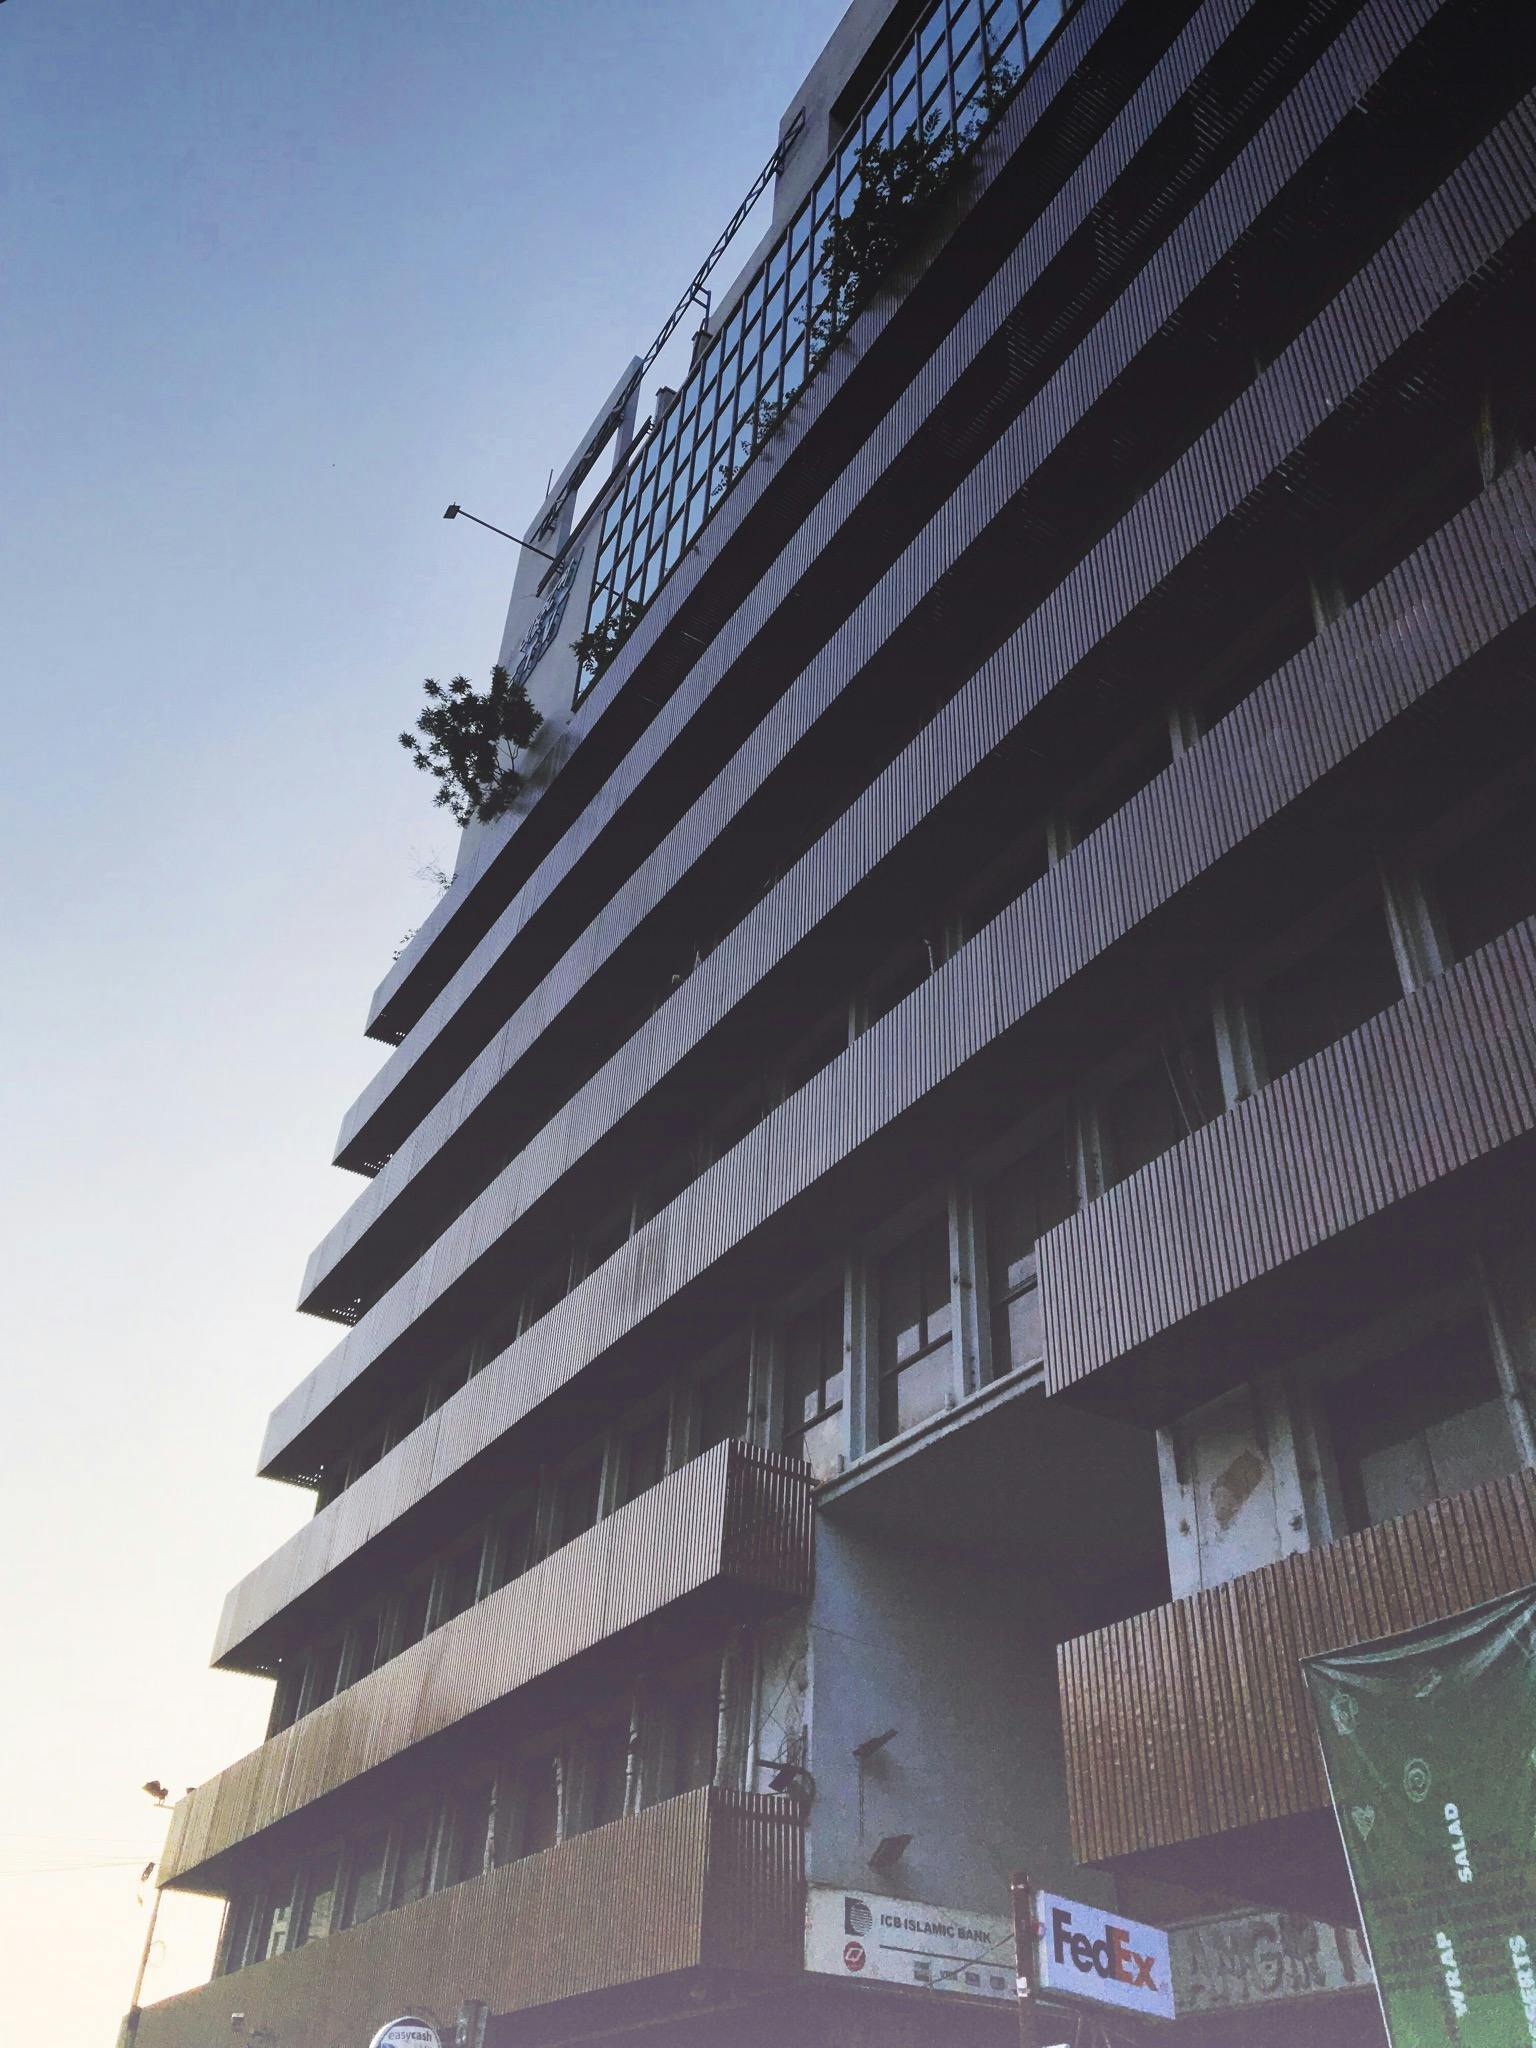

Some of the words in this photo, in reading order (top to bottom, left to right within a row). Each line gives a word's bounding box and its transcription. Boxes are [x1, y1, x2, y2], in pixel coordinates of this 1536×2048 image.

[1444, 1803, 1473, 1883] SALAD
[880, 1914, 901, 1929] ICB
[904, 1918, 955, 1938] ISLAMIC
[958, 1927, 992, 1943] BANK
[1052, 1907, 1158, 1991] FedEx
[1436, 1931, 1468, 2018] WRAP
[388, 2031, 432, 2042] easycash
